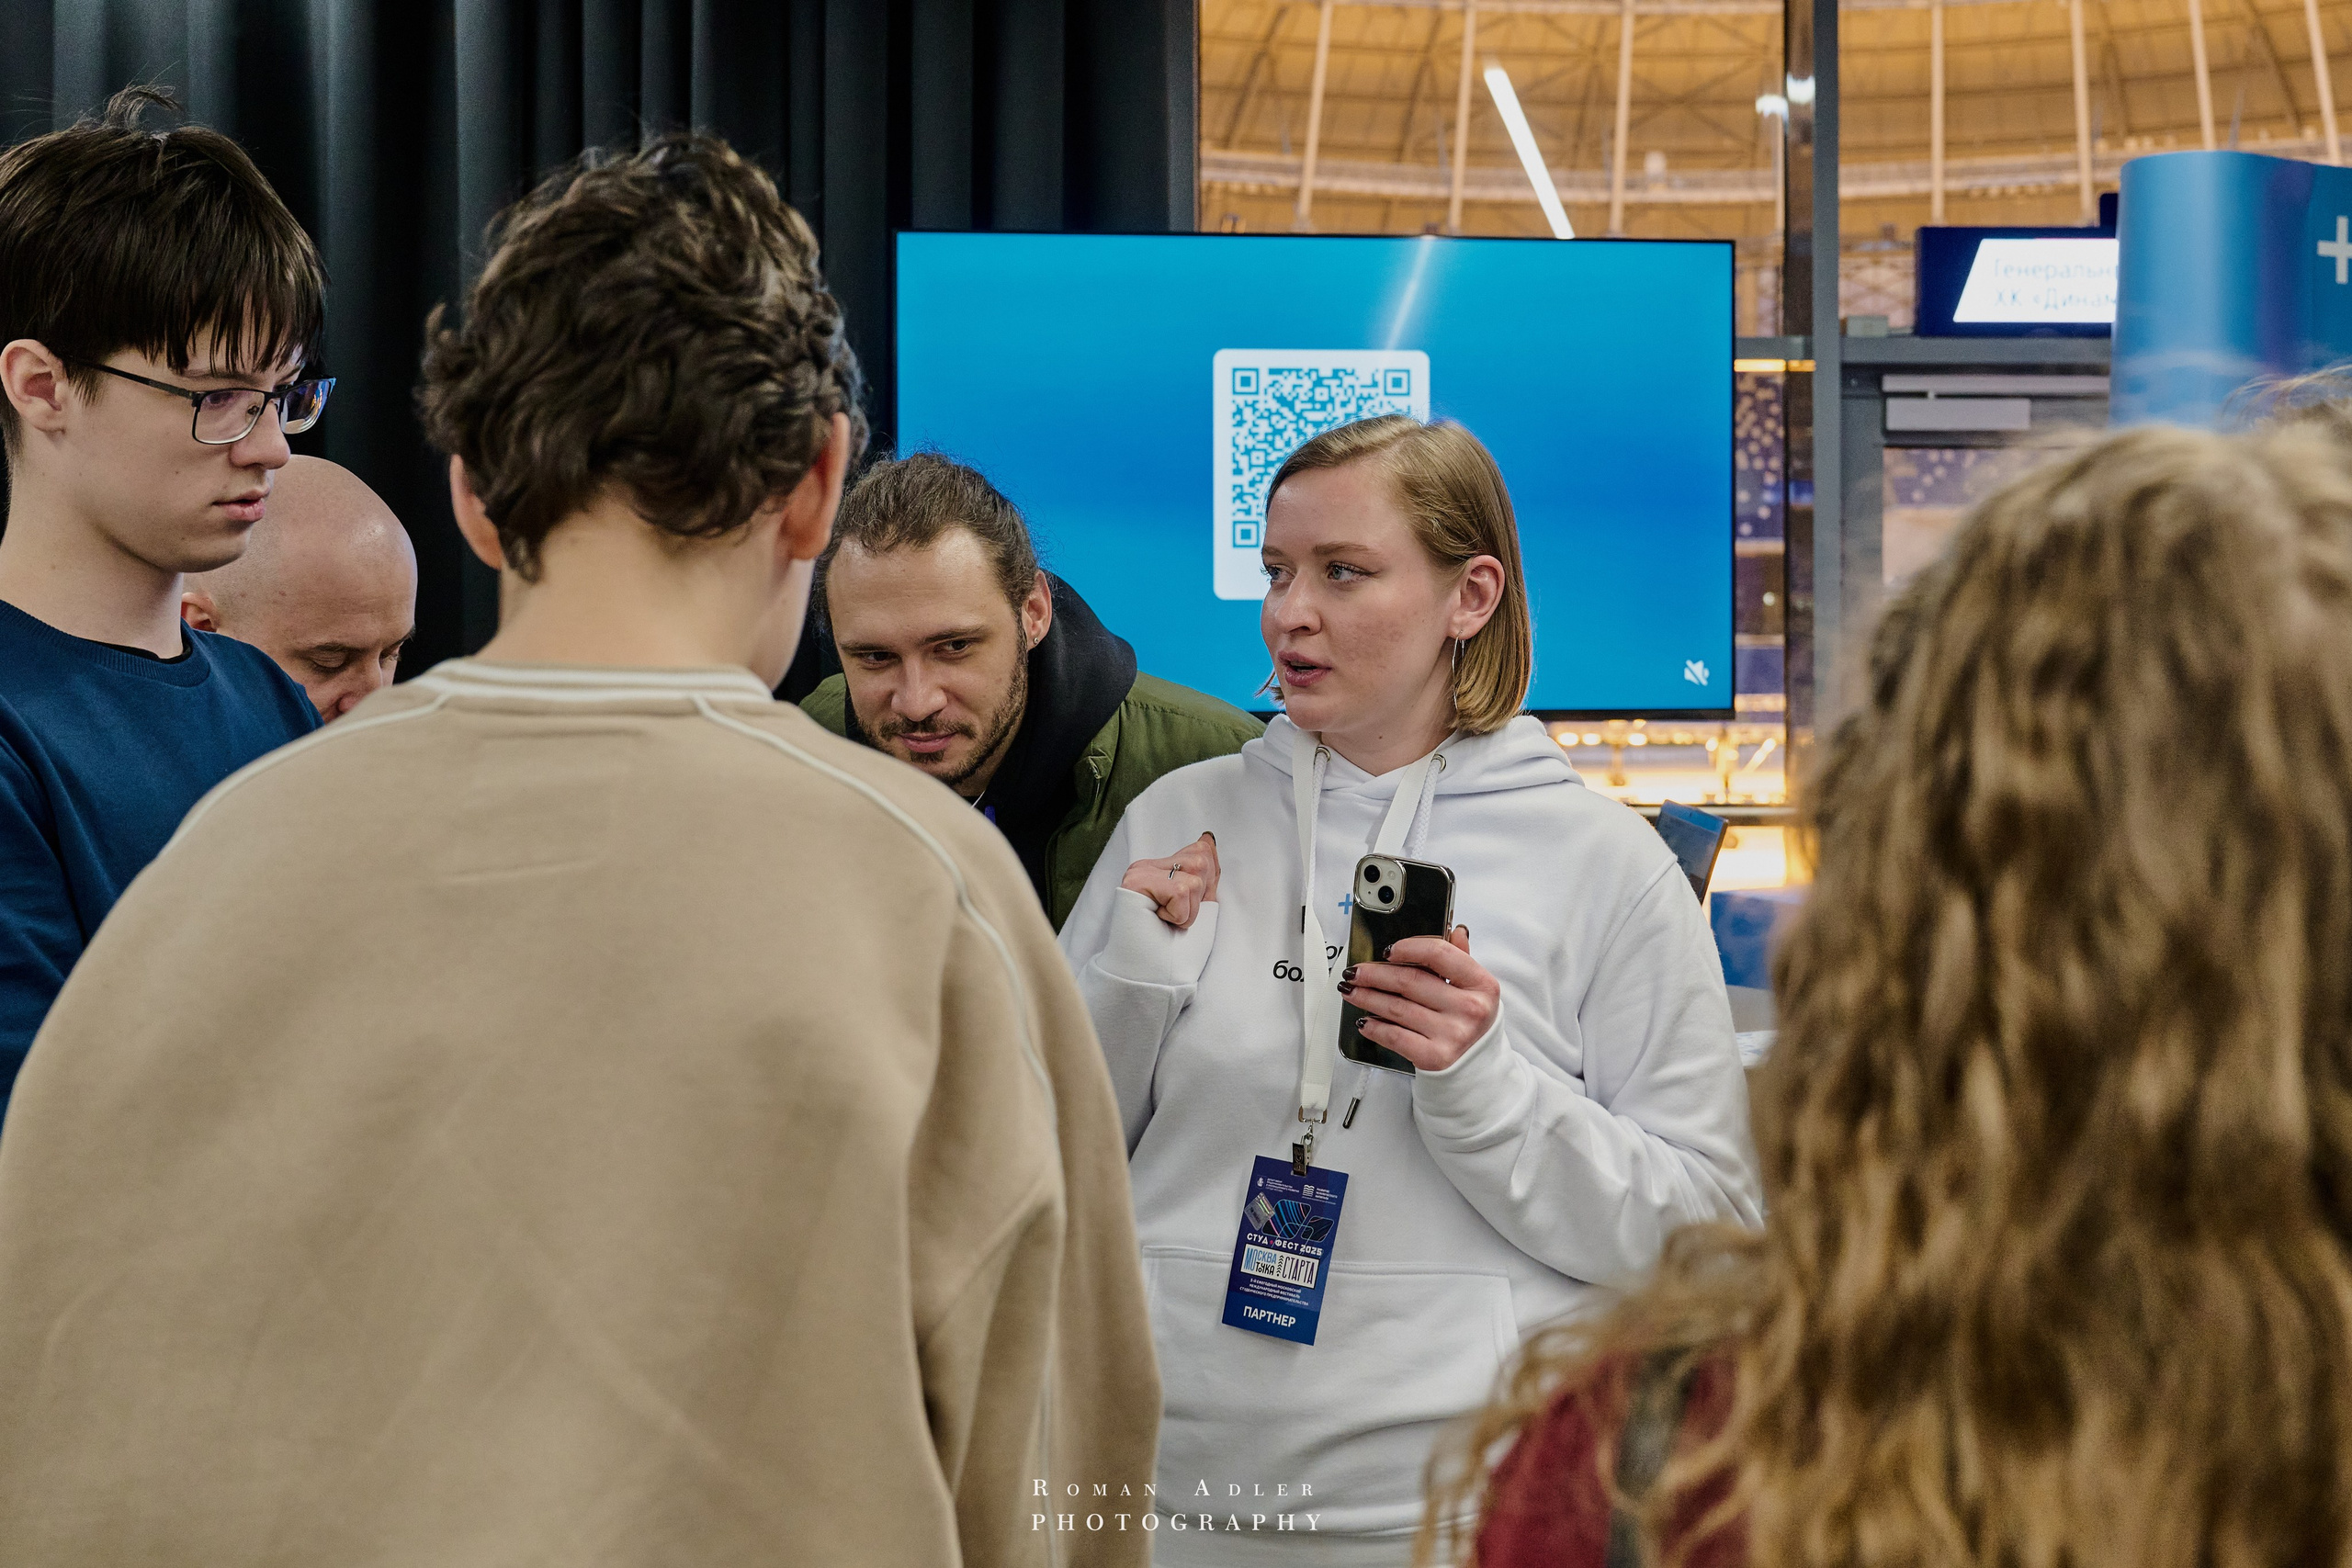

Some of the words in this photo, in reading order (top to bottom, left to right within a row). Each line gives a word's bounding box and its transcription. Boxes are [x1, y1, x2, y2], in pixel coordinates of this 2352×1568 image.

[1994, 258, 2119, 280] Генеральн
[1994, 288, 2022, 307] ХК
[1274, 1239, 1300, 1251] ФЕСТ
[1299, 1244, 1323, 1257] 2025
[1282, 1256, 1315, 1285] СТАРТА
[1243, 1305, 1296, 1327] ПАРТНЕР
